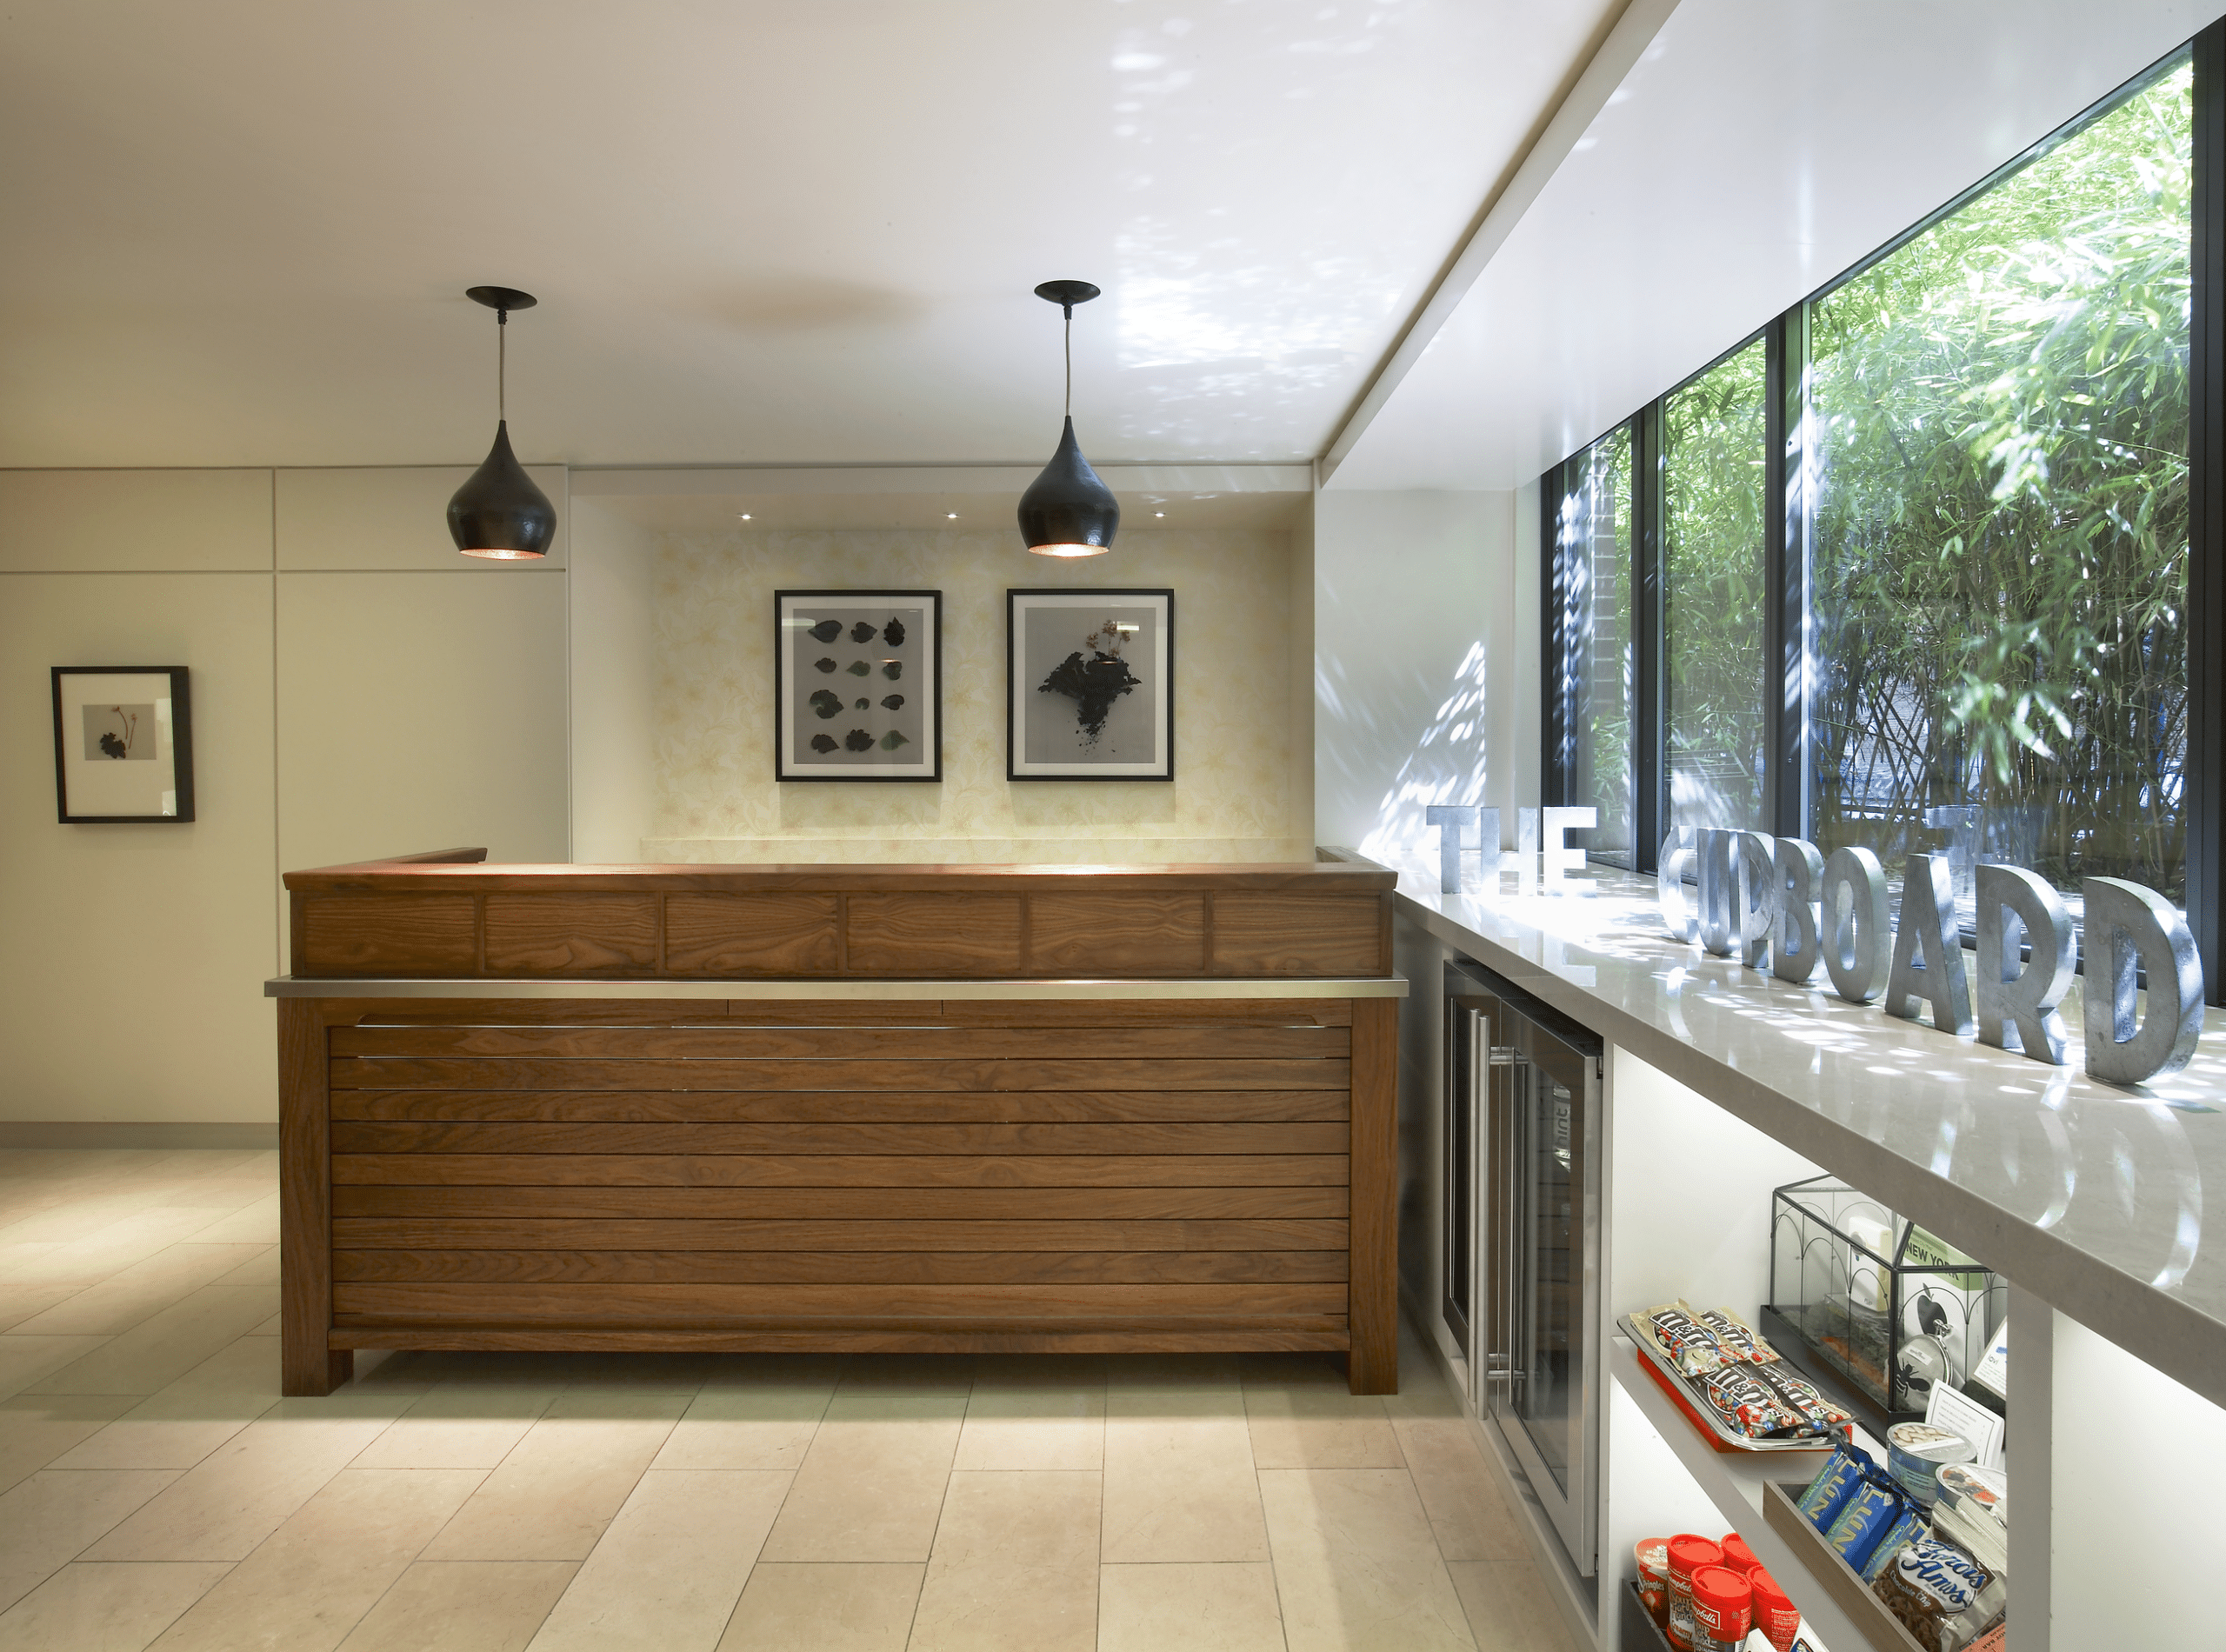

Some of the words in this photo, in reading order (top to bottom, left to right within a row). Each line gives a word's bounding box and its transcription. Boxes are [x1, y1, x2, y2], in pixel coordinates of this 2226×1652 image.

[1426, 805, 1597, 898] THE
[1658, 825, 2205, 1085] CUPBOARD
[1906, 1242, 1928, 1262] NEW
[1808, 1458, 1857, 1521] LUN
[1832, 1489, 1884, 1555] LUN
[1643, 1579, 1665, 1591] Pringles
[1889, 1569, 1916, 1596] Chocolate
[1916, 1590, 1932, 1609] Chip
[1901, 1560, 1968, 1609] Amos
